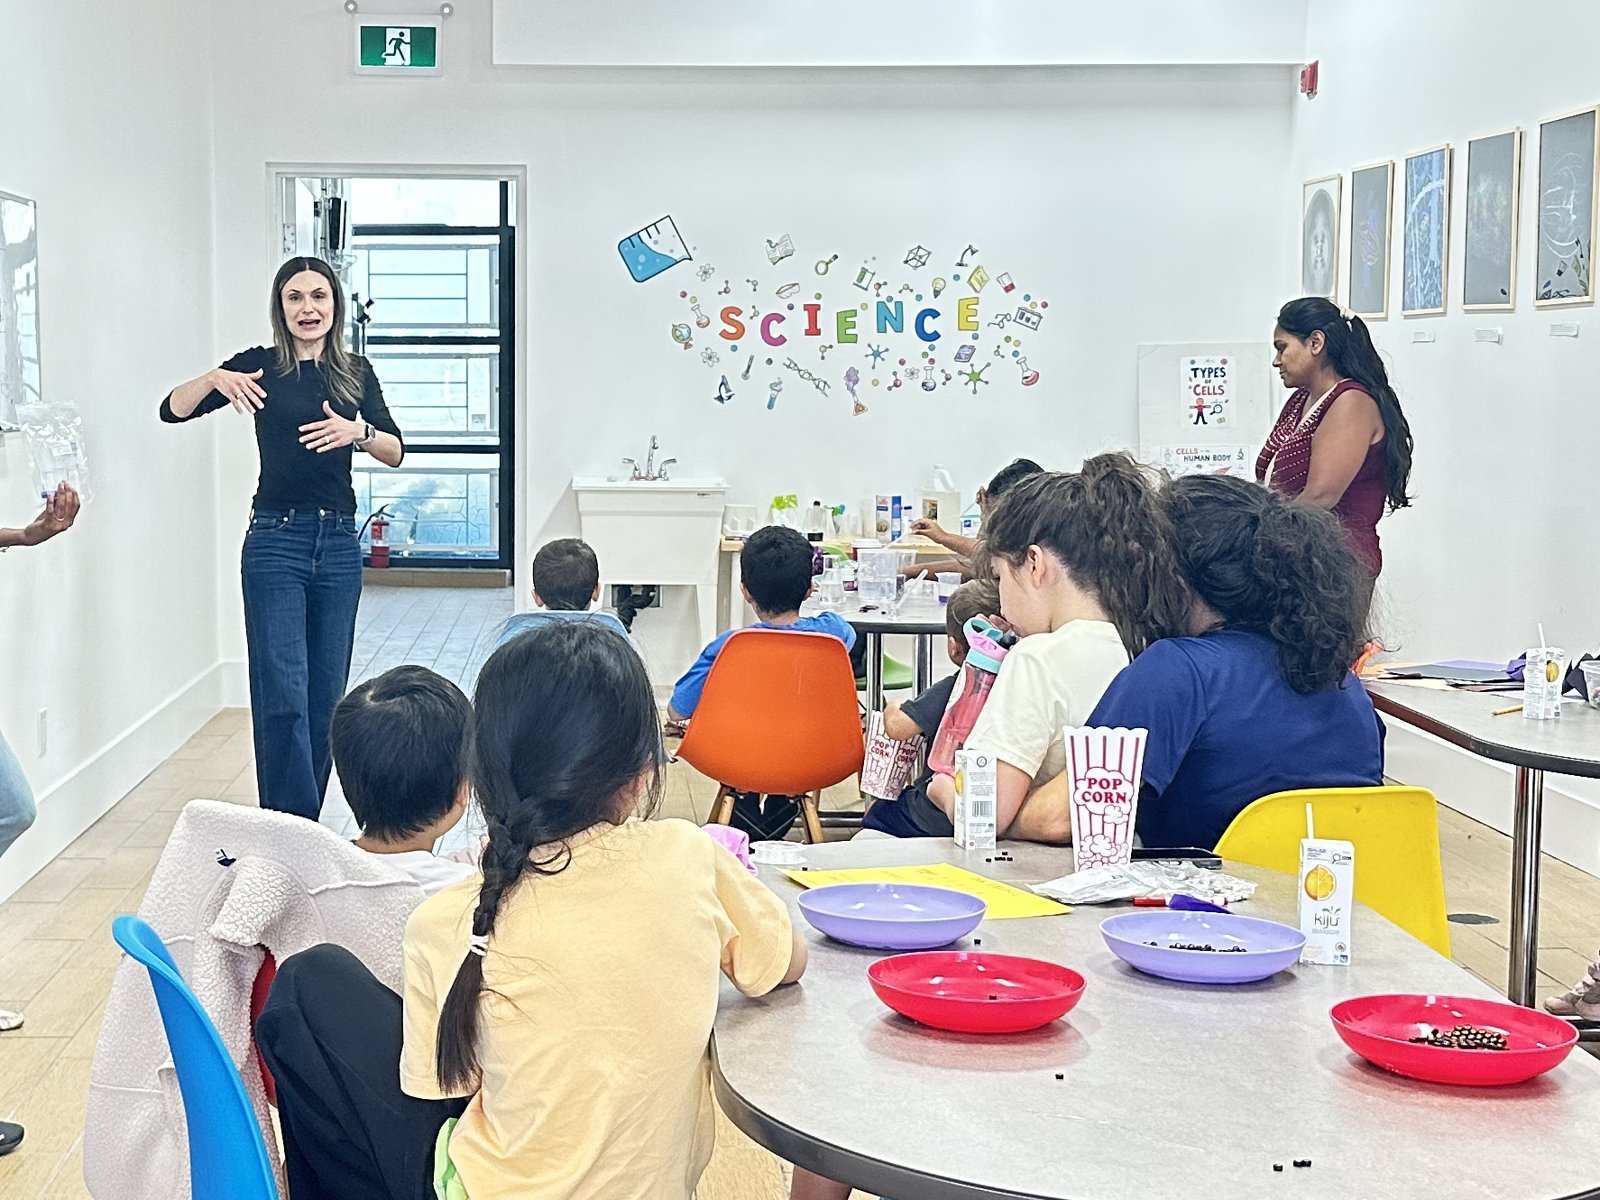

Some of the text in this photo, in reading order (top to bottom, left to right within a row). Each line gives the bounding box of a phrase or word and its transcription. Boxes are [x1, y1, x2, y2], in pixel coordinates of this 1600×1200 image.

[719, 296, 980, 347] SCIENCE
[1191, 367, 1226, 378] TYPES
[1193, 384, 1225, 396] CELLS
[1183, 454, 1231, 462] HUMAN BODY
[875, 740, 890, 749] POP
[1087, 777, 1123, 790] POP
[1081, 790, 1127, 804] CORN
[1314, 913, 1340, 929] kiju
